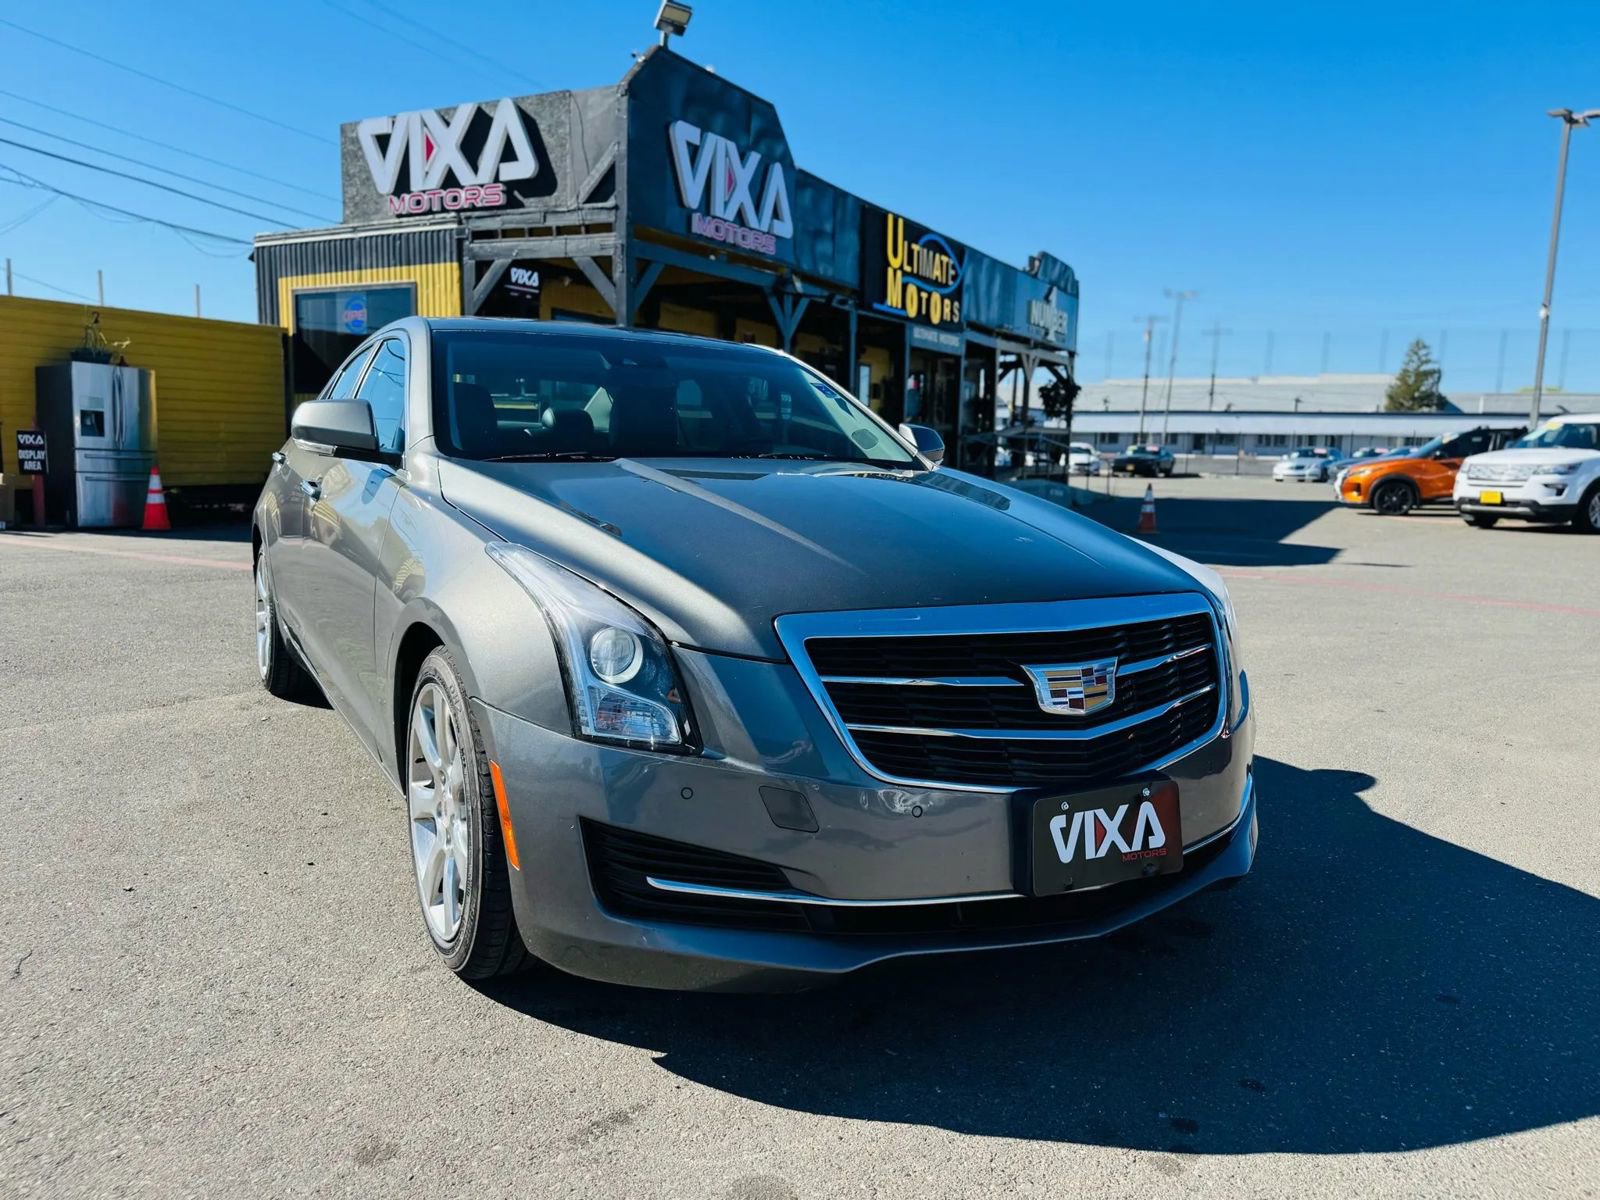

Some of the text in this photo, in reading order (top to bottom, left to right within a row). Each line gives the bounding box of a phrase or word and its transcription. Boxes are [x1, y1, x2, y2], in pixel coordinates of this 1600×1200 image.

[358, 97, 539, 195] VIXA
[669, 120, 794, 239] VIXA
[388, 183, 506, 215] MOTORS
[691, 212, 776, 255] MOTORS
[511, 267, 539, 287] VIXA
[887, 266, 960, 325] MOTORS
[17, 434, 44, 445] VIXA
[18, 449, 46, 460] DISPLAY
[23, 461, 42, 470] AREA
[1049, 801, 1166, 864] VIXA
[1121, 848, 1168, 862] MOTORS
